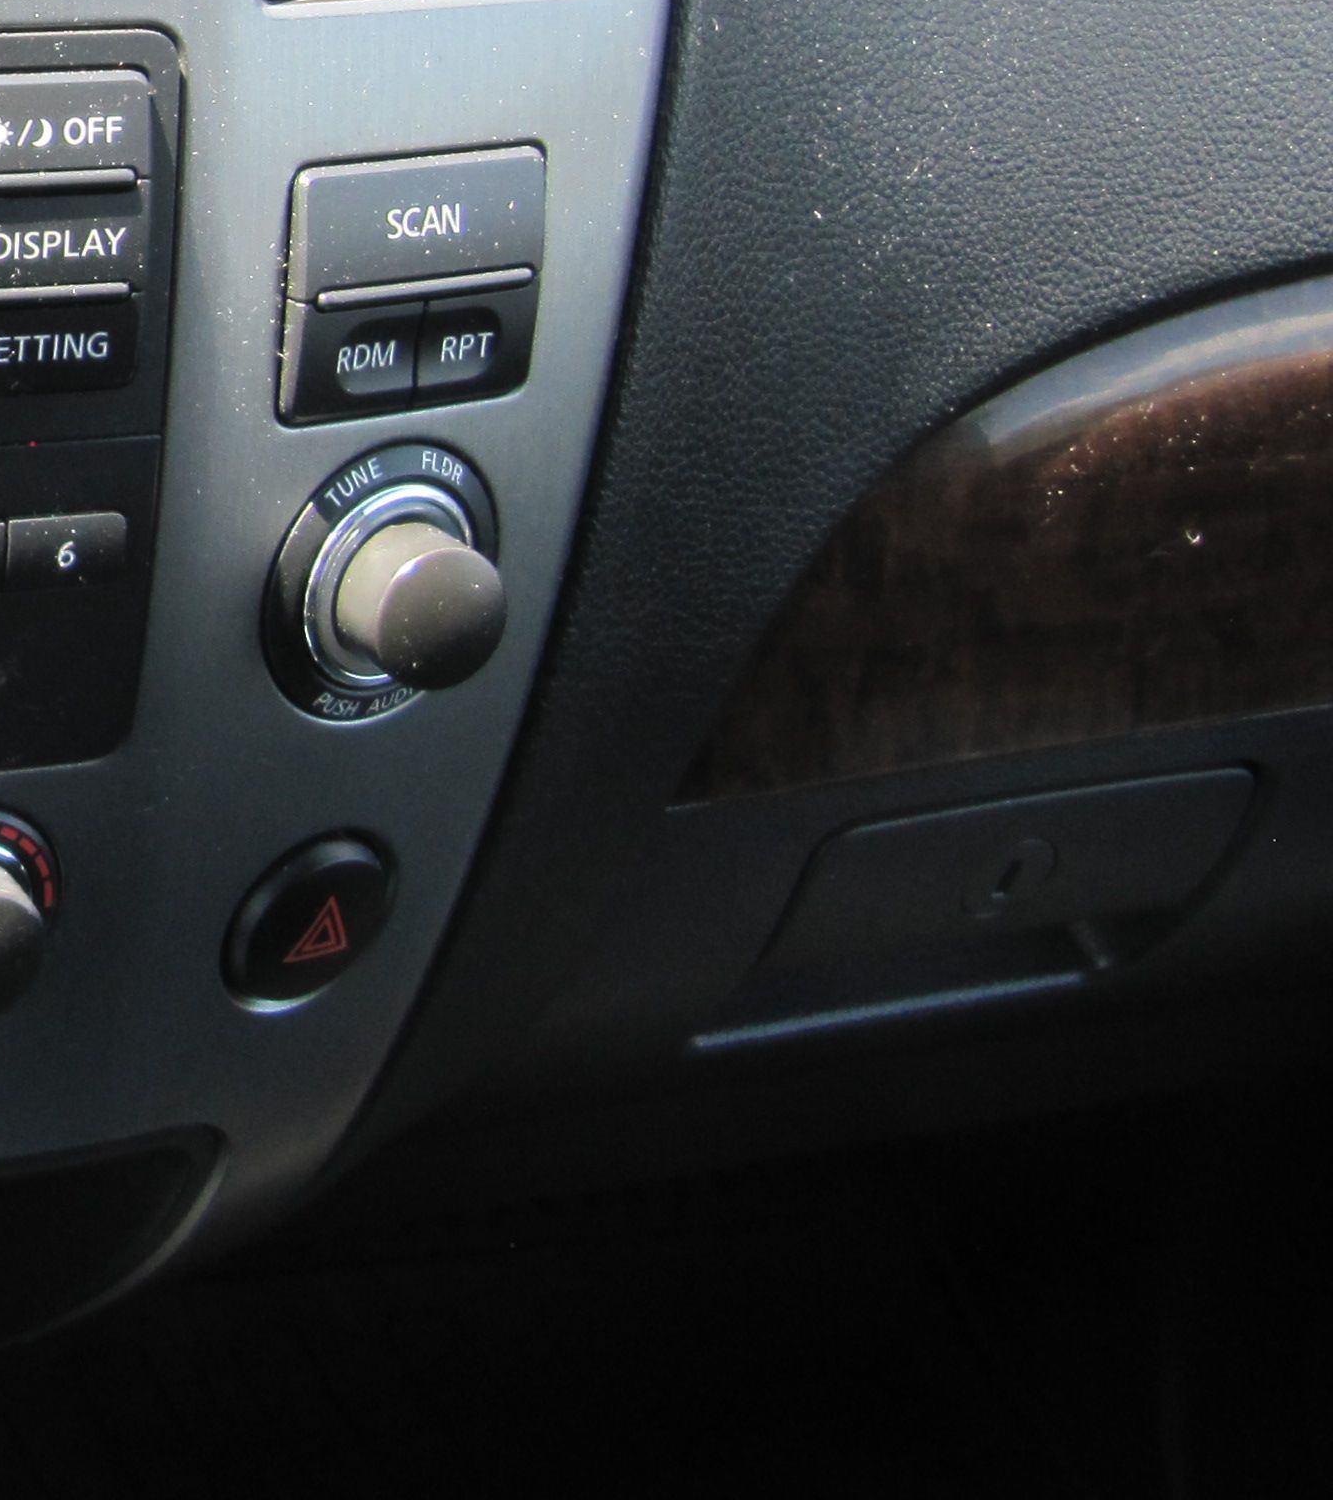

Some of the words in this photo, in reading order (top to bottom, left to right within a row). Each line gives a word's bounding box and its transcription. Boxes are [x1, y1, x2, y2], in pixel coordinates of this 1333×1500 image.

[63, 116, 123, 145] OFF
[386, 202, 462, 240] SCAN
[335, 339, 397, 375] RDM
[440, 331, 495, 364] RPT
[323, 457, 384, 508] TUNE
[421, 450, 464, 486] FLDR
[57, 541, 76, 568] 6
